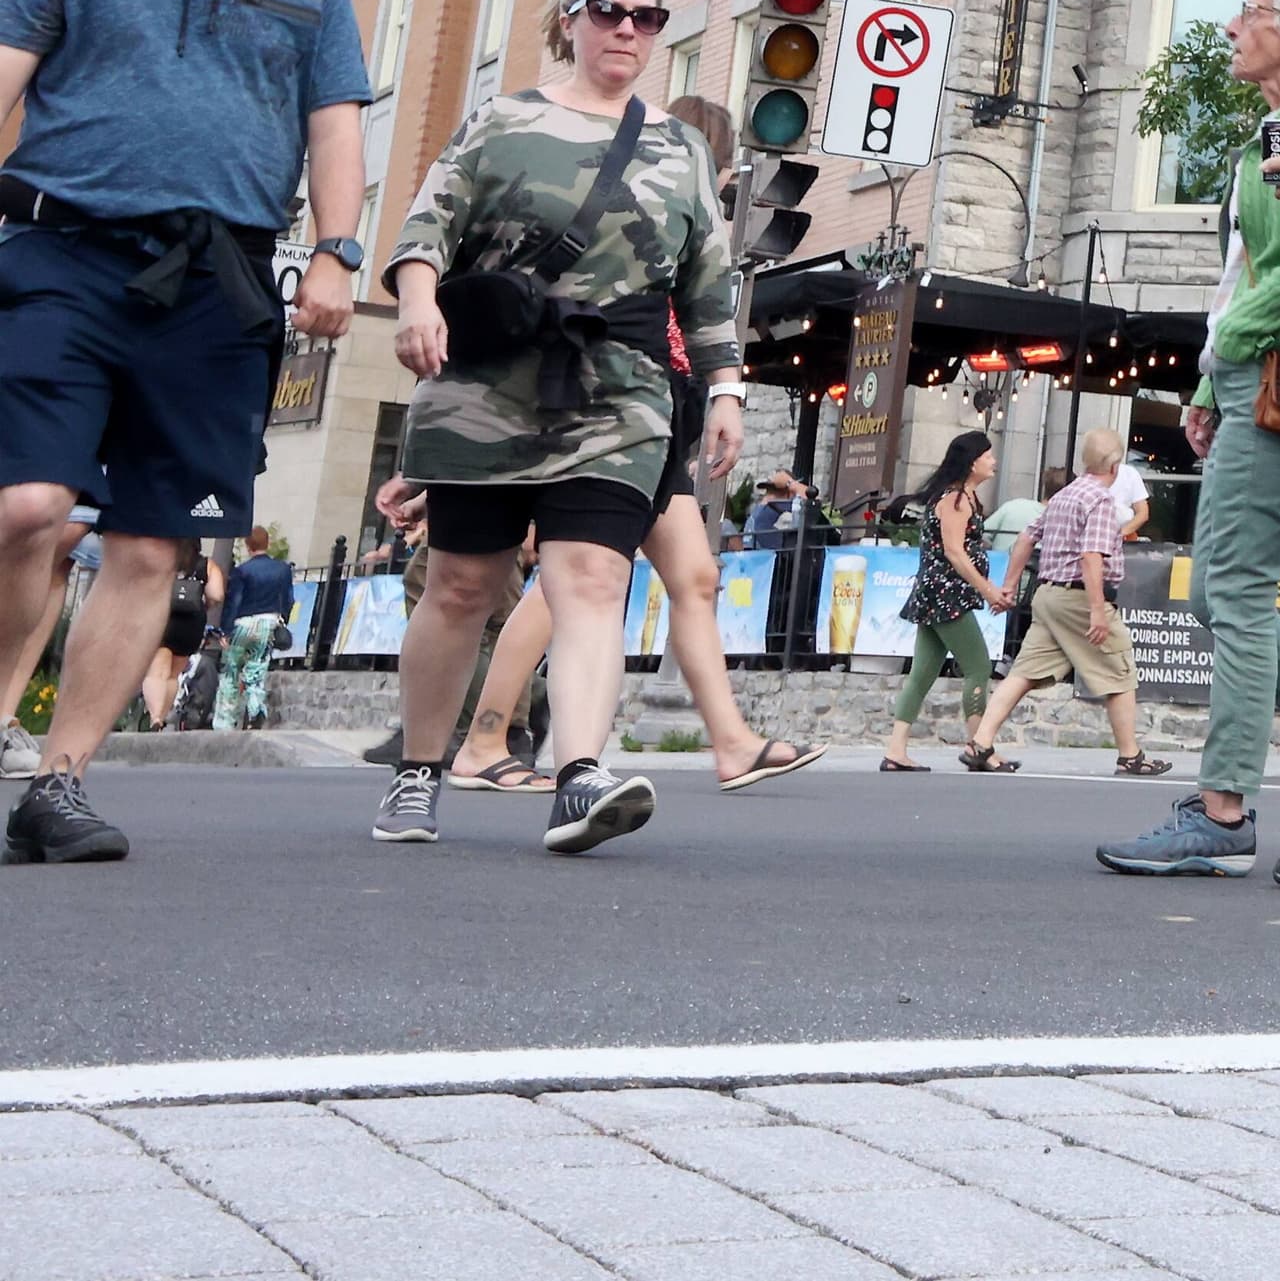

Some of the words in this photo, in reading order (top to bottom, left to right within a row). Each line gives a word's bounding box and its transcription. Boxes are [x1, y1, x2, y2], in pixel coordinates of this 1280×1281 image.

[275, 248, 312, 261] IMUM
[190, 509, 224, 517] adidas
[1122, 607, 1204, 629] LAISSEZ-PASS
[1127, 627, 1191, 646] OURBOIRE
[1163, 649, 1214, 667] EMPLOY
[1136, 667, 1214, 685] ONNAISSAN
